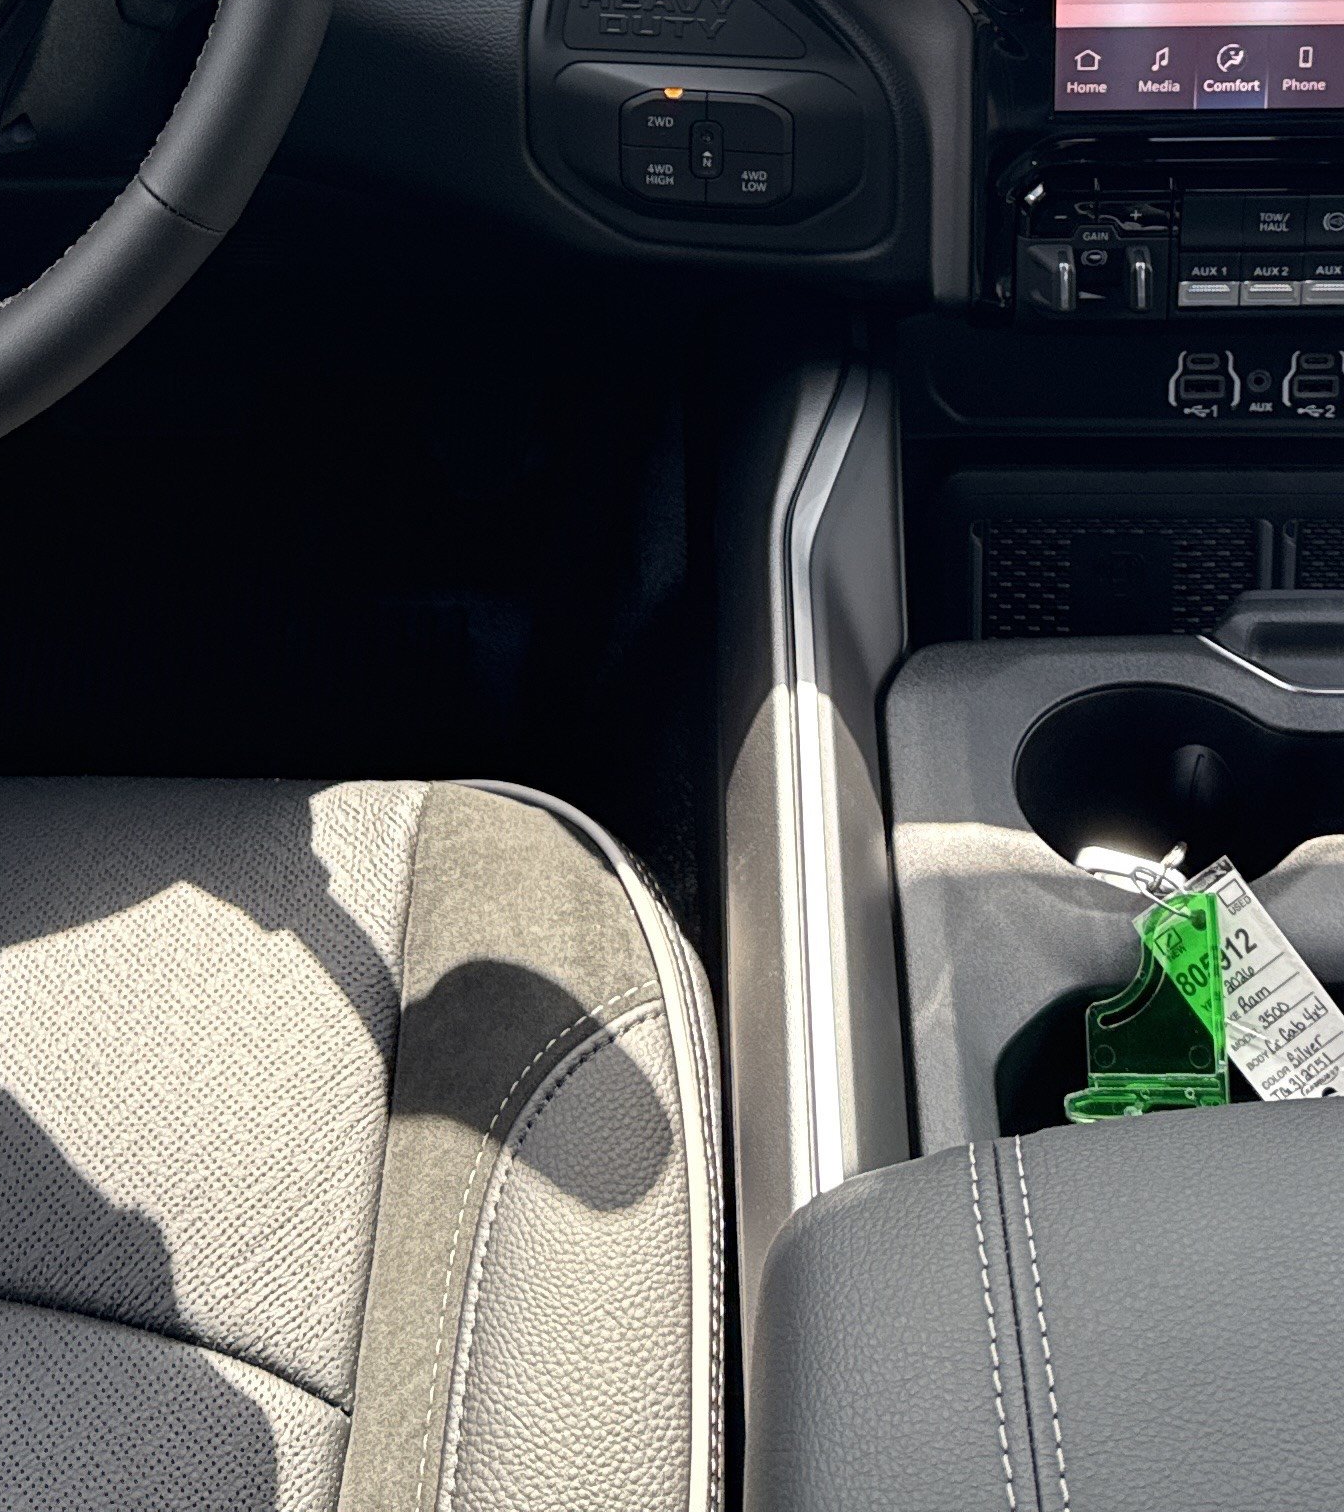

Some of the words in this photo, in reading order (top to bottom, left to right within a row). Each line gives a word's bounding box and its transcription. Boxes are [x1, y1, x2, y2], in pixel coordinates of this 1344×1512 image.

[597, 13, 728, 40] DUTY
[1066, 81, 1109, 94] Home
[1138, 79, 1181, 93] Media
[1203, 79, 1261, 92] Comfort
[1282, 78, 1327, 91] Phone
[646, 115, 675, 129] 2WD
[646, 163, 674, 175] 4WD
[645, 174, 675, 186] HIGH
[741, 170, 768, 183] 4WD
[741, 182, 768, 193] LOW
[1259, 211, 1290, 223] TOW/
[1259, 222, 1290, 232] HAUL
[1082, 231, 1109, 242] GAIN
[1191, 266, 1221, 277] AUX
[1221, 266, 1227, 276] 1
[1253, 266, 1281, 277] AUX
[1281, 266, 1290, 276] 2
[1315, 265, 1344, 275] AUX
[1211, 405, 1219, 418] 1
[1249, 402, 1273, 413] AUX
[1324, 405, 1336, 418] 2
[1228, 894, 1252, 917] USED
[1223, 965, 1256, 995] 2026
[1237, 986, 1273, 1014] Ram
[1258, 1001, 1290, 1030] 3500
[1286, 1033, 1323, 1069] Silver
[1245, 1050, 1270, 1072] BODY
[1261, 1065, 1292, 1091] COLOR
